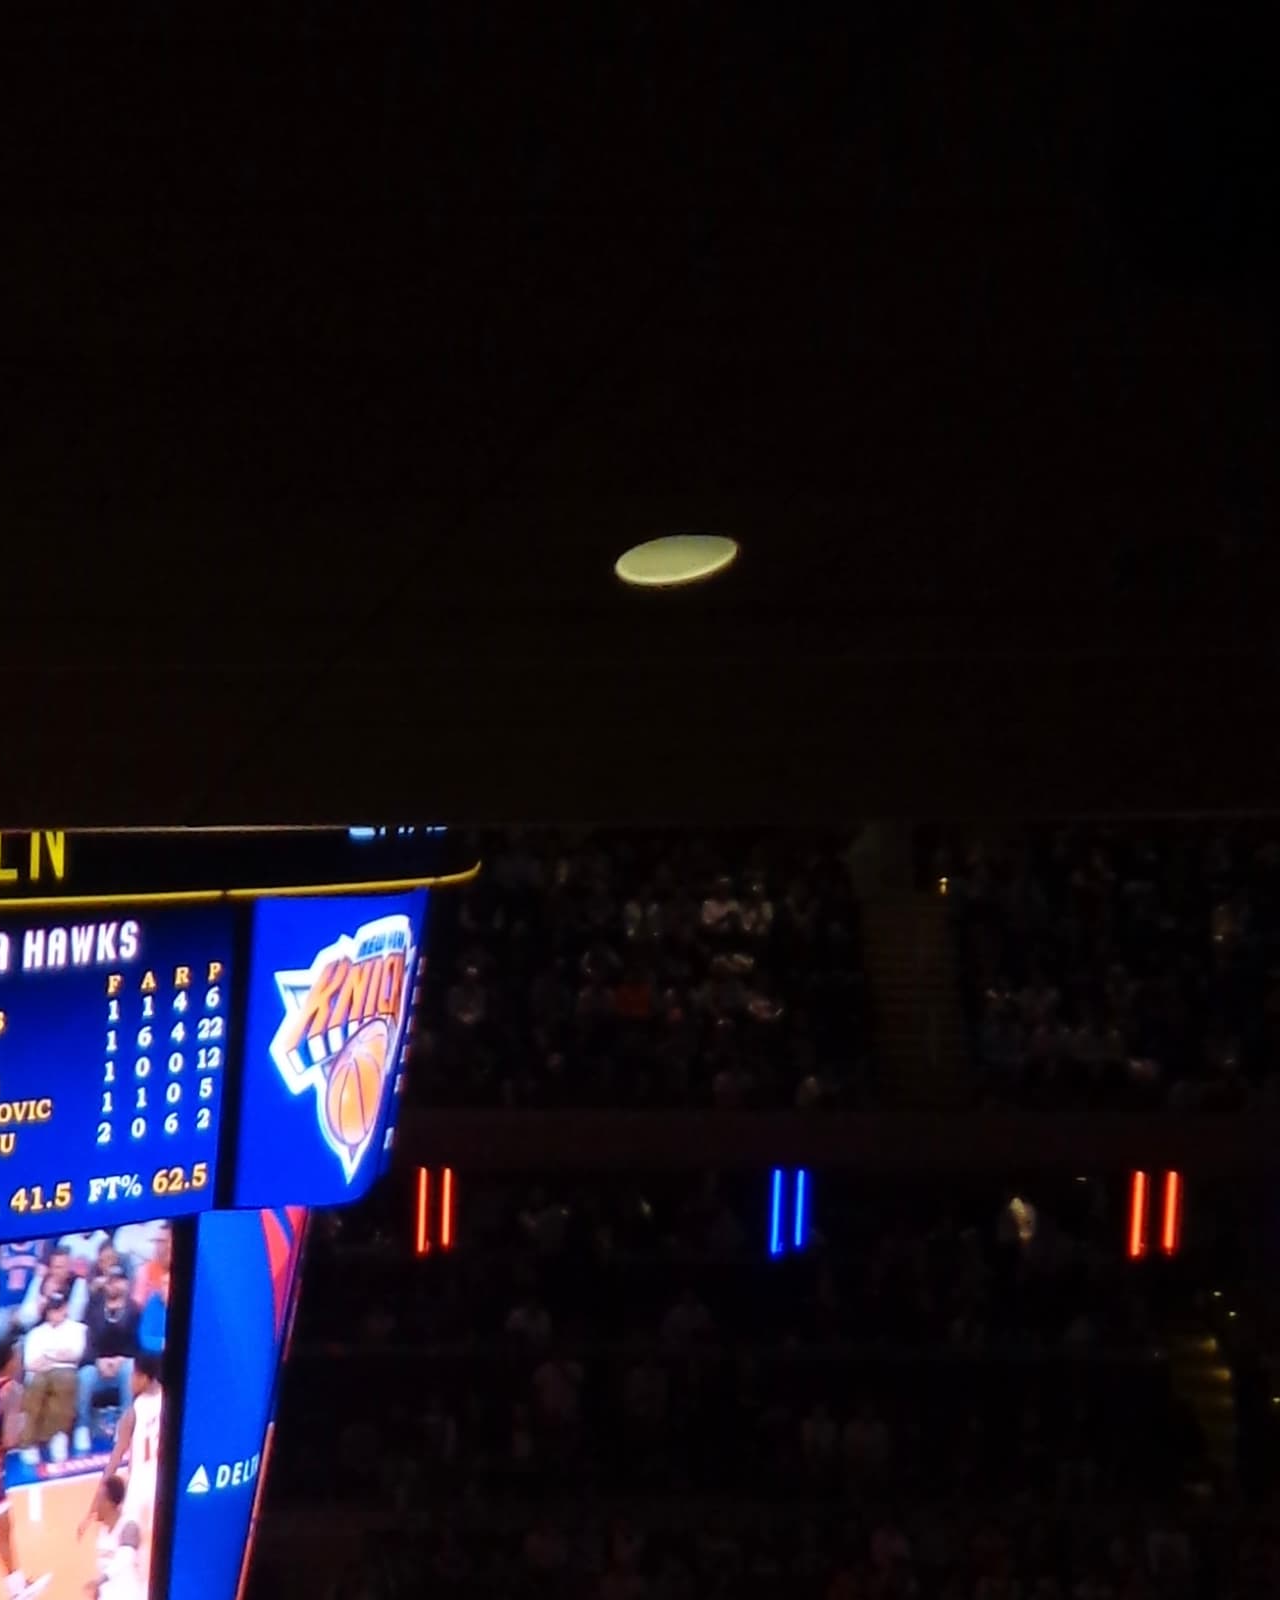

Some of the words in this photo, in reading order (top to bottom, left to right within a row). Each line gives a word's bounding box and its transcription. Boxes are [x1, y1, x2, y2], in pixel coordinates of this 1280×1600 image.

[23, 920, 139, 969] HAWKS
[107, 975, 122, 994] F
[141, 971, 157, 991] A
[174, 966, 190, 986] R
[208, 962, 222, 981] P
[108, 999, 119, 1021] 1
[142, 995, 154, 1017] 1
[173, 990, 188, 1012] 4
[205, 986, 220, 1008] 6
[106, 1030, 117, 1052] 1
[137, 1026, 153, 1048] 6
[171, 1021, 186, 1042] 4
[197, 1016, 224, 1040] 22
[104, 1061, 115, 1082] 1
[135, 1057, 151, 1077] 0
[168, 1052, 184, 1073] 0
[197, 1046, 221, 1069] 12
[102, 1091, 113, 1113] 1
[136, 1087, 147, 1108] 1
[166, 1082, 181, 1103] 0
[199, 1077, 213, 1098] 5
[97, 1122, 112, 1143] 2
[131, 1117, 146, 1138] 0
[164, 1112, 179, 1134] 6
[196, 1108, 211, 1129] 2
[10, 1182, 72, 1213] 41.5
[88, 1174, 143, 1203] FT%
[152, 1162, 207, 1195] 62.5
